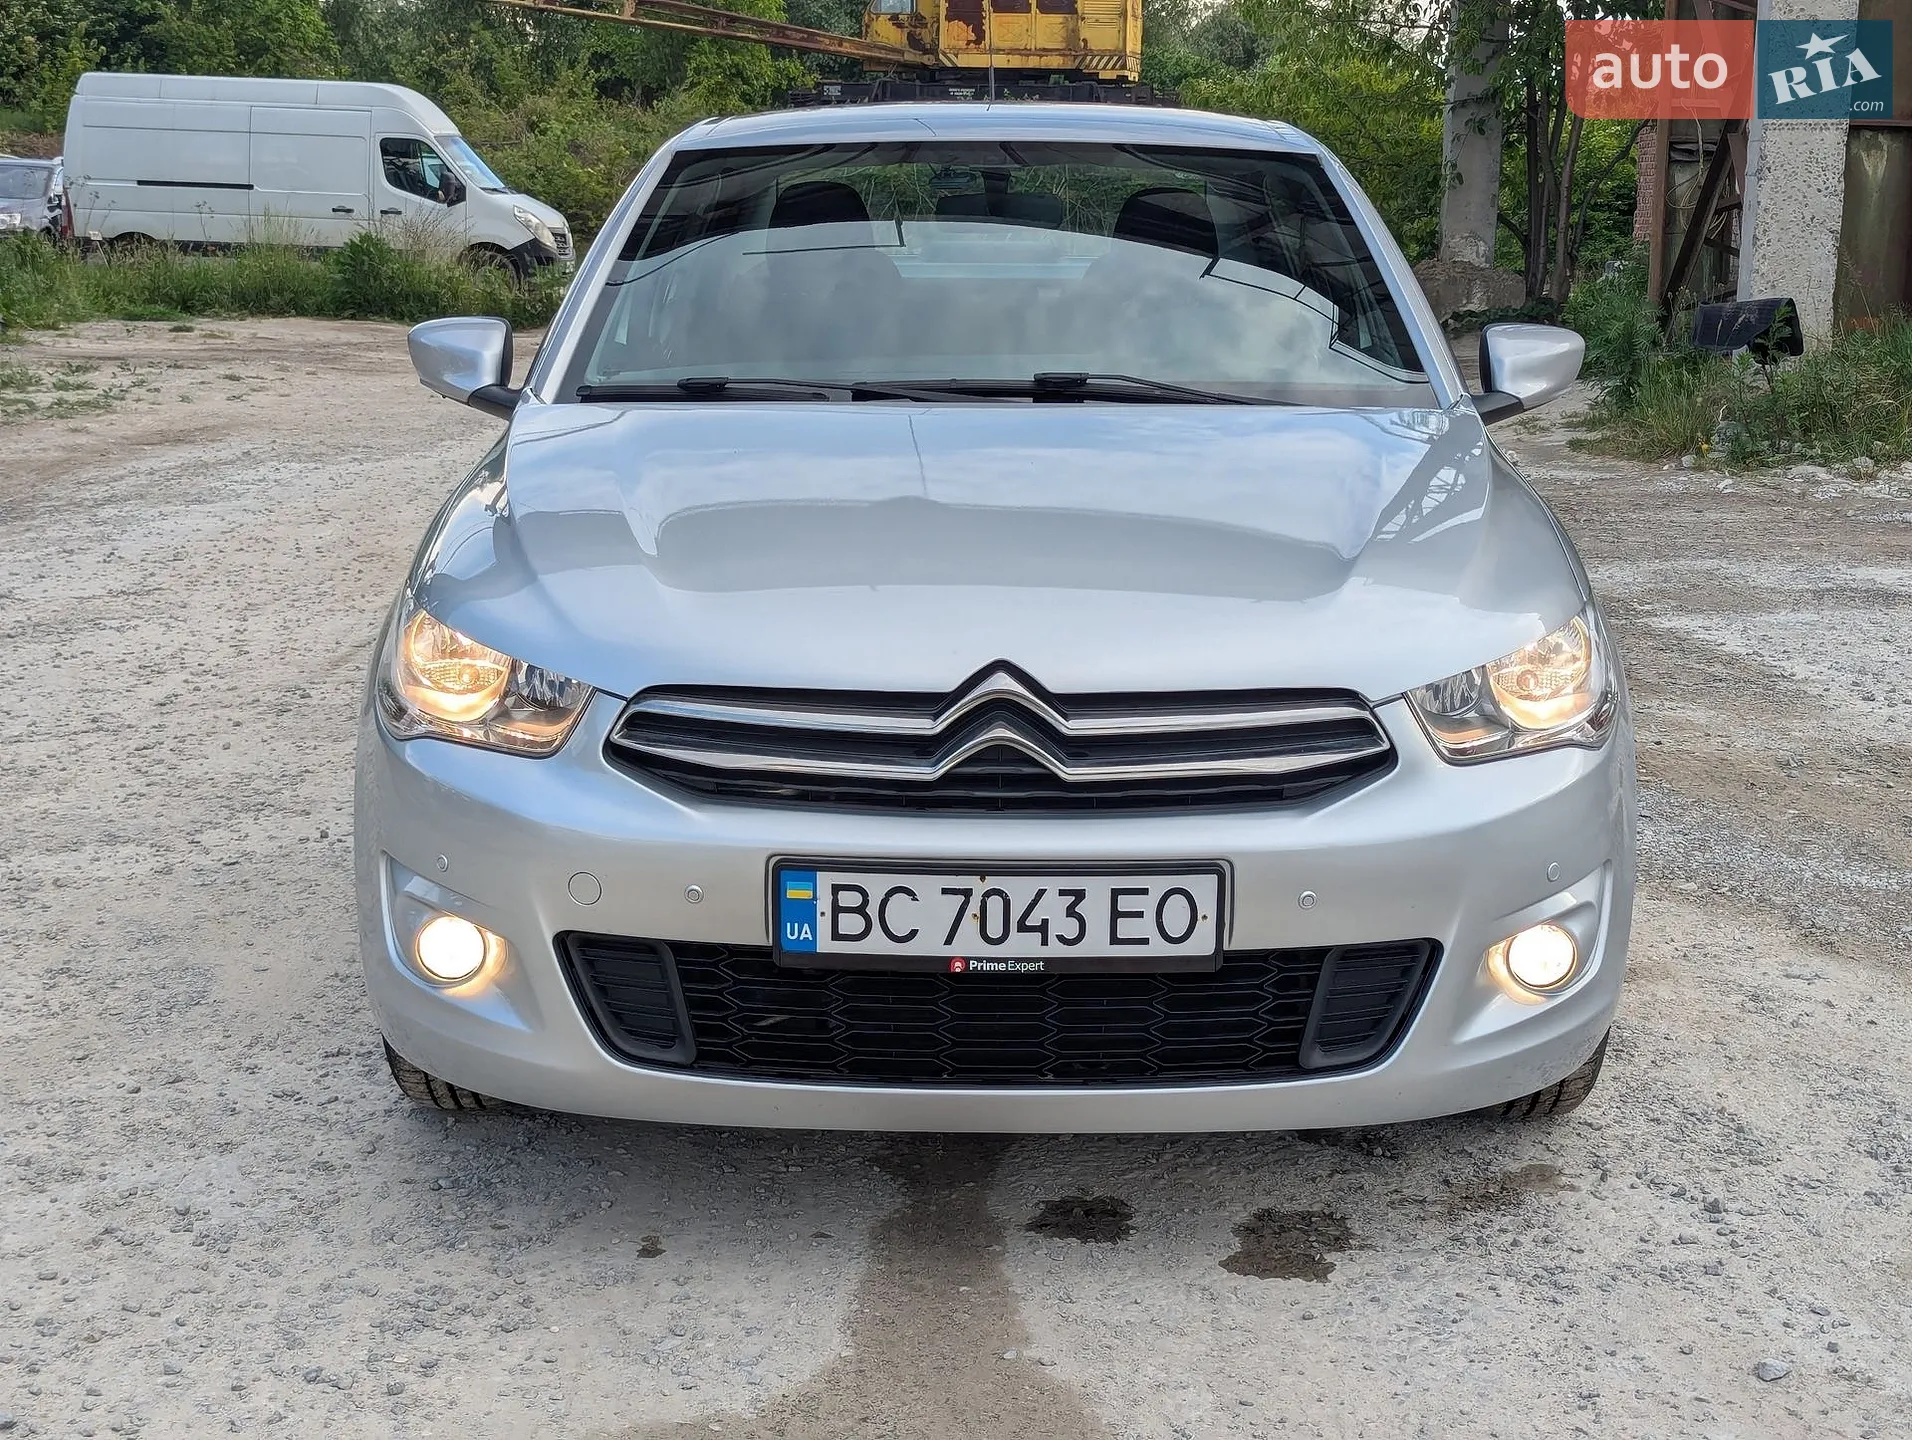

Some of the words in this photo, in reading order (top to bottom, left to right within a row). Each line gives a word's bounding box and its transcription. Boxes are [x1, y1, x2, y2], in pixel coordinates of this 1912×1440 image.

[831, 884, 920, 943] BC
[941, 888, 1087, 946] 7043
[1110, 887, 1198, 945] EO
[786, 923, 813, 941] UA
[969, 959, 1007, 971] Prime
[1008, 960, 1045, 974] Expert
